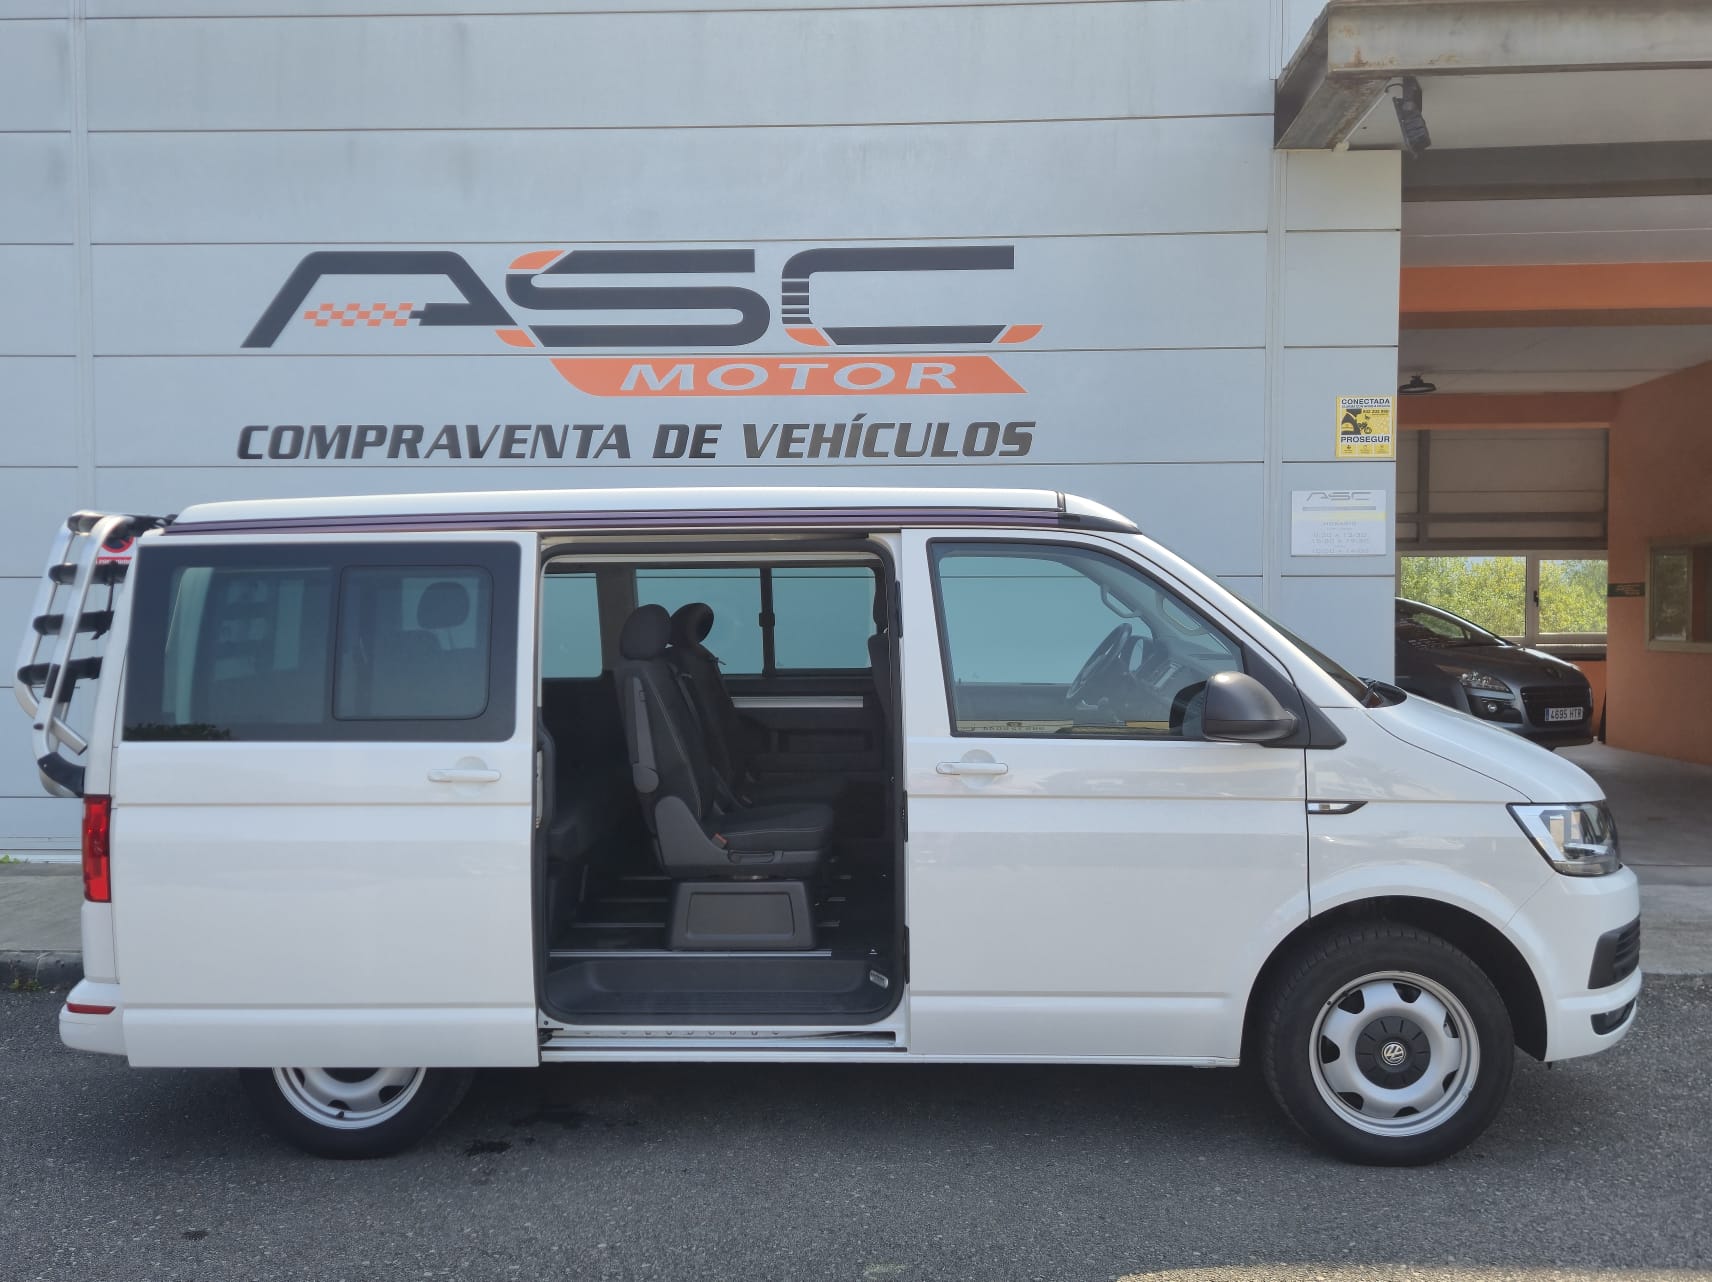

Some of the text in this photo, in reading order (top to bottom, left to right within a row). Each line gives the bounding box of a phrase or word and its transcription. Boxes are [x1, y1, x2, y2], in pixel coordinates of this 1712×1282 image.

[240, 246, 1043, 348] ASC
[620, 362, 957, 391] MOTOR
[237, 413, 1036, 459] COMPRAVENTA DE VEHÍCULOS
[1341, 435, 1390, 443] PROSEGUR
[1306, 491, 1371, 501] ASC
[1551, 709, 1568, 719] 4695
